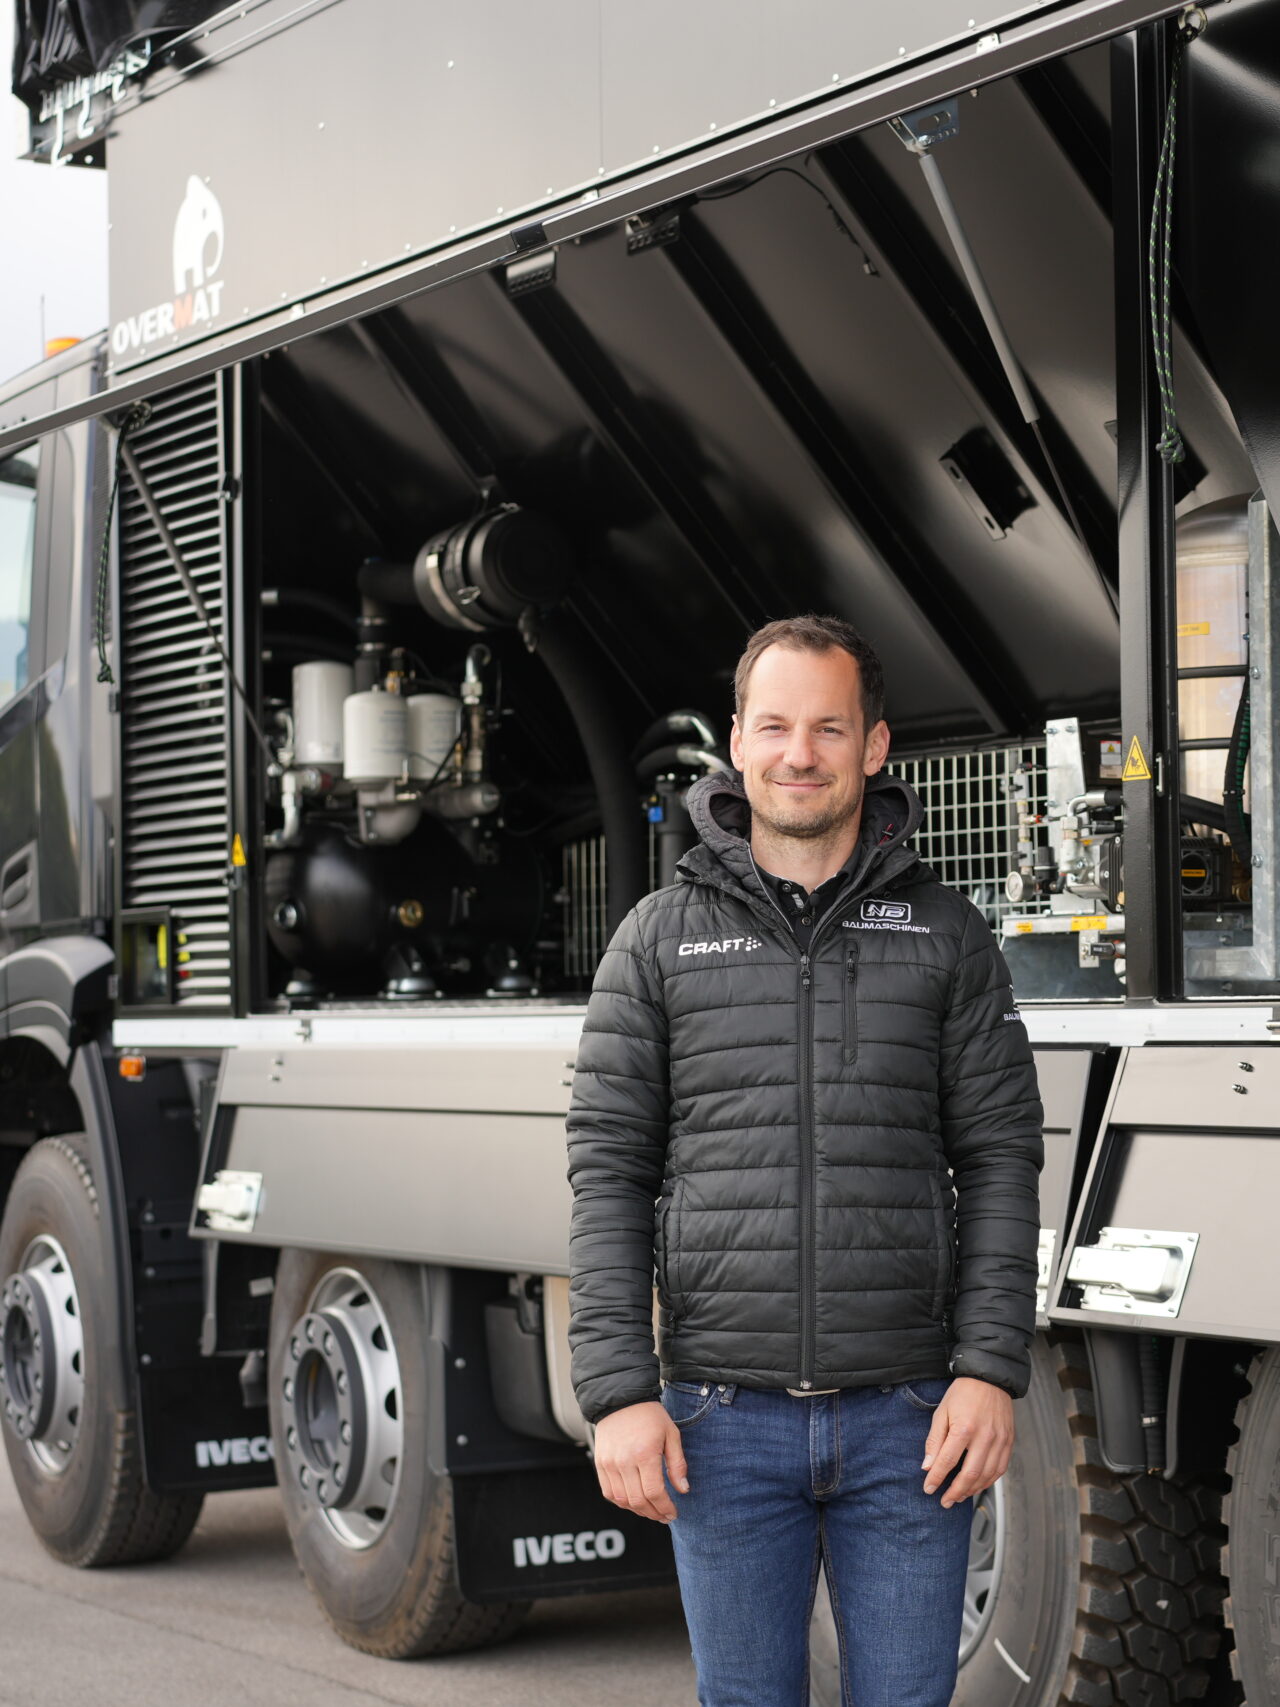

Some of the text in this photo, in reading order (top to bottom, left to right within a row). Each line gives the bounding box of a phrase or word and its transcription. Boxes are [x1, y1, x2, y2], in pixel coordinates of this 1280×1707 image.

[112, 280, 224, 354] OVERMAT
[842, 920, 930, 933] BAUMASCHINEN
[678, 938, 744, 956] CRAFT
[513, 1529, 625, 1567] IVECO
